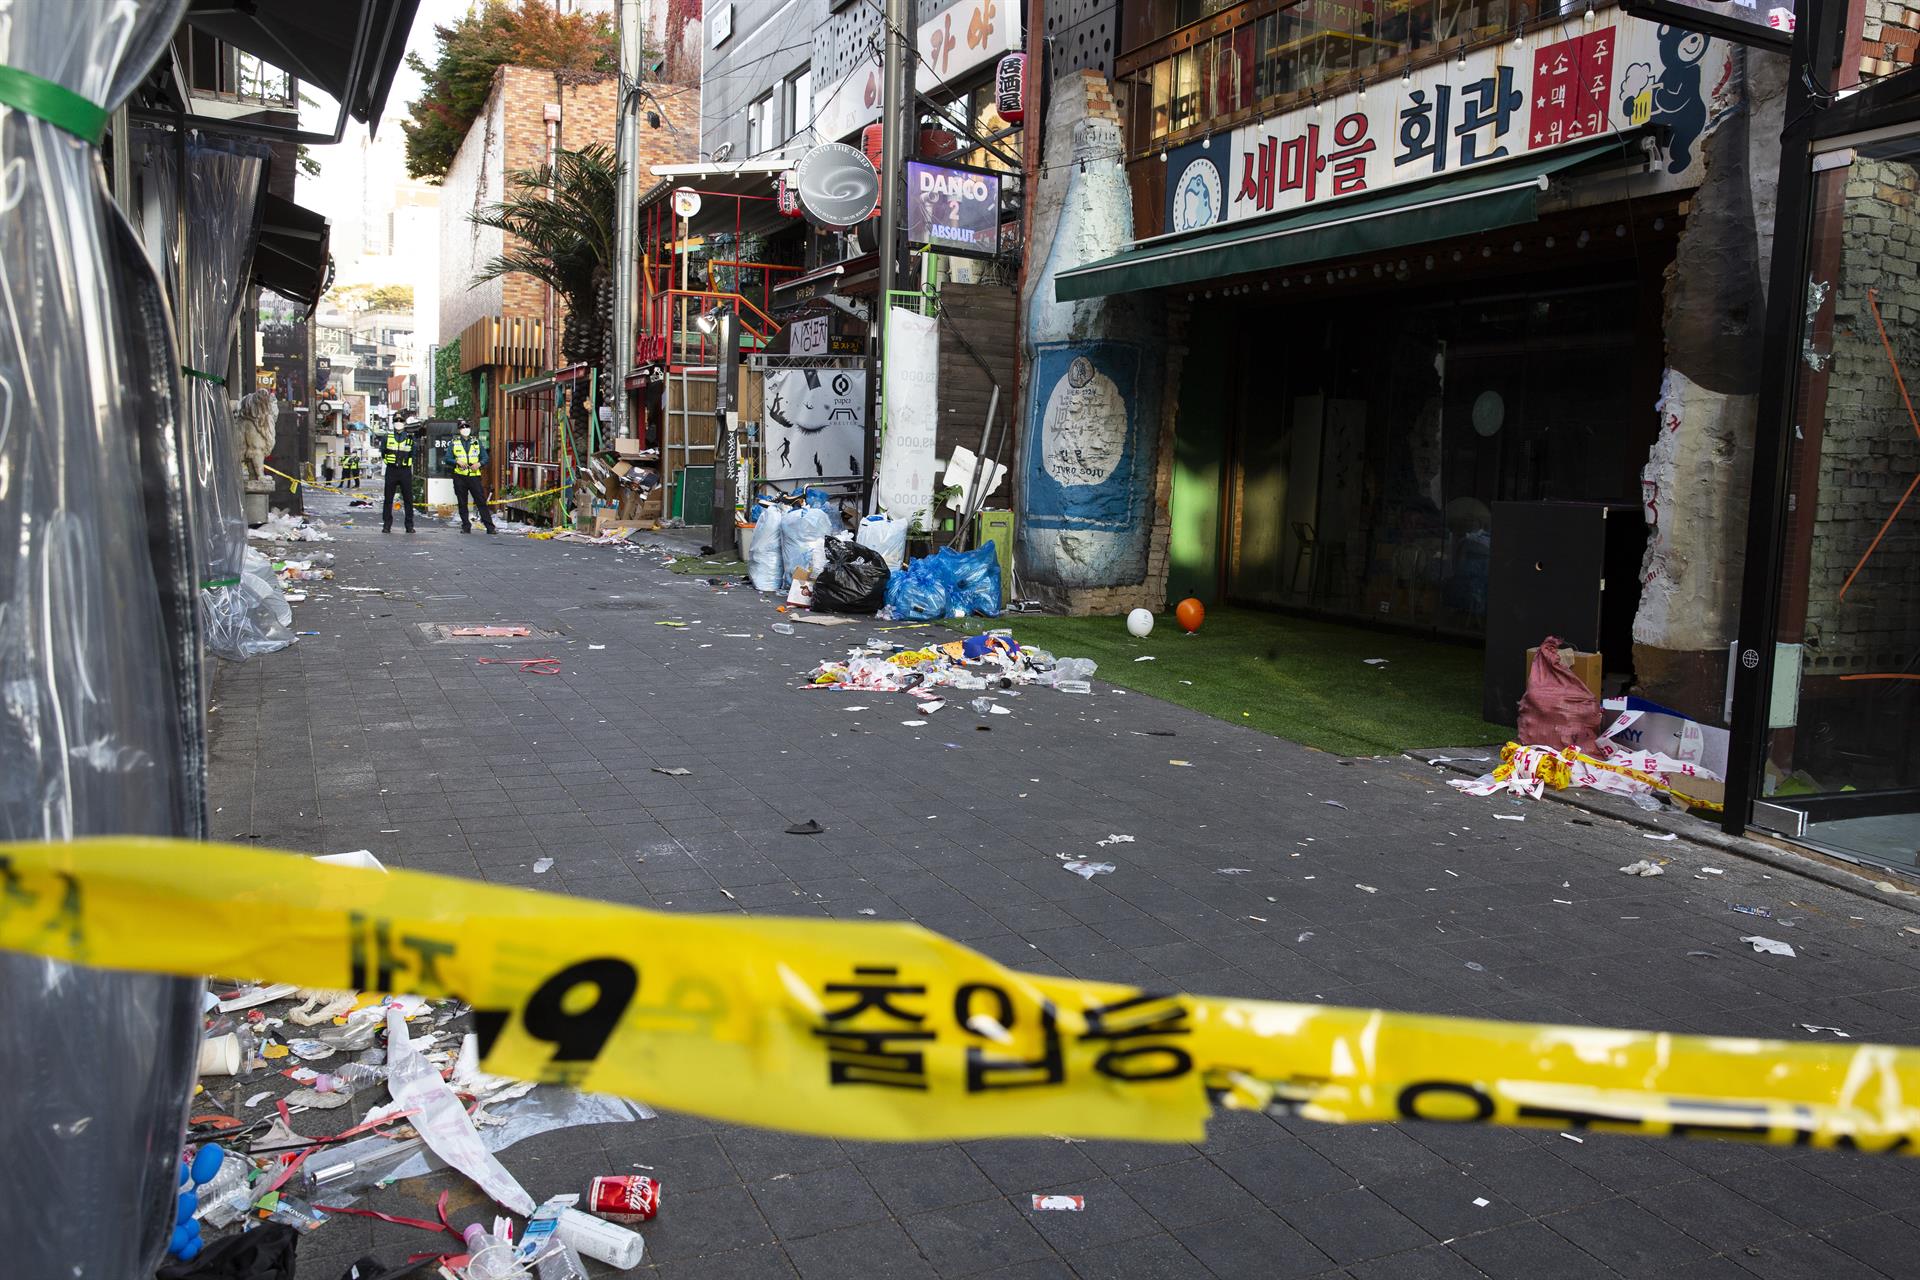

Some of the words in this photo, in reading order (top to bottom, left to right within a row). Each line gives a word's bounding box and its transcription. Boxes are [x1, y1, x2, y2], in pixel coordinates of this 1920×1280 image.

[1234, 111, 1378, 212] 새마을
[1393, 64, 1523, 173] 회관
[1547, 109, 1603, 145] 위스키
[800, 158, 812, 175] DIVE
[811, 145, 830, 158] INTO
[832, 144, 850, 154] THE
[851, 150, 870, 168] DEEP
